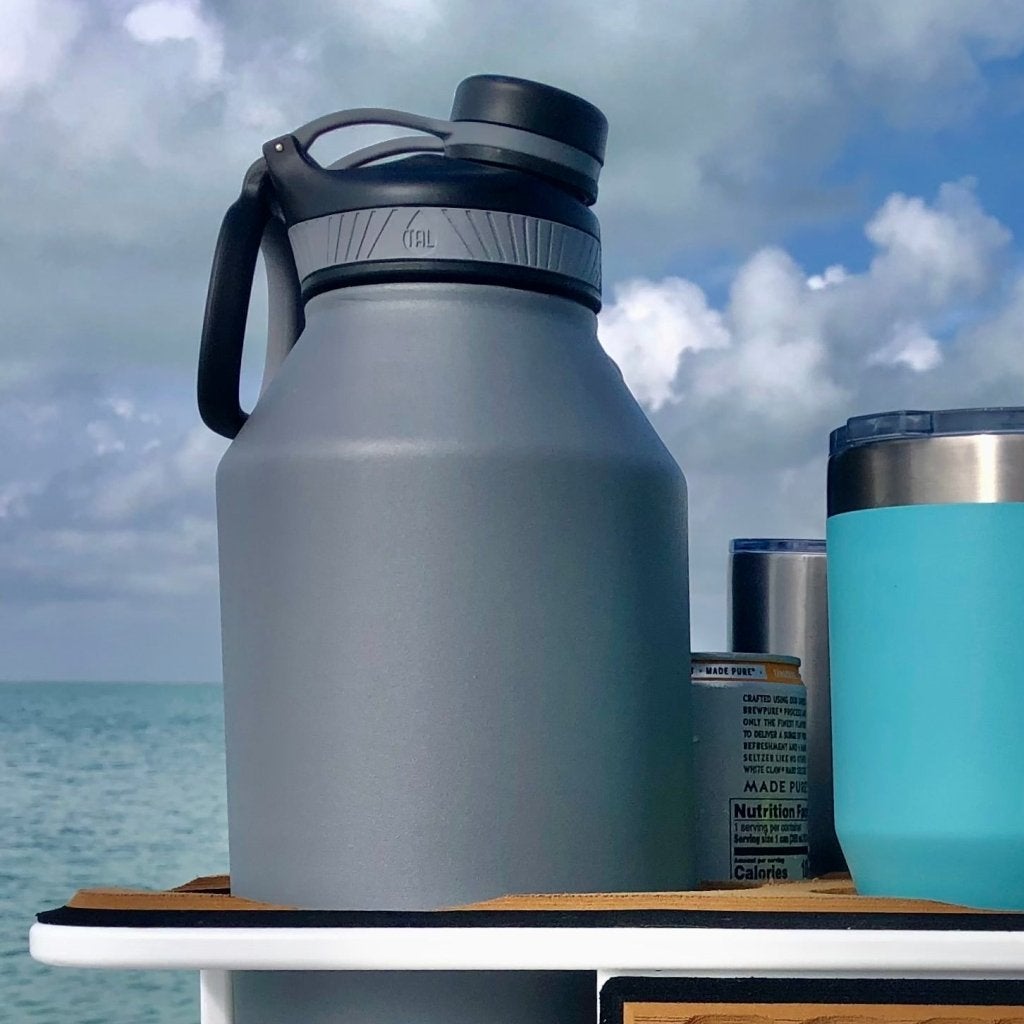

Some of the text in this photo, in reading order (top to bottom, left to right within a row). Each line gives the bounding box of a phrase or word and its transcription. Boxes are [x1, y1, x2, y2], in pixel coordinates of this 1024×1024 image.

[406, 229, 435, 248] TAL
[706, 667, 729, 675] MADE
[743, 694, 771, 703] CRAFTED
[743, 718, 760, 727] ONLY
[764, 719, 776, 727] THE
[743, 730, 752, 738] TO
[754, 730, 778, 739] DELIVER
[743, 742, 788, 751] REFRESHMENT
[743, 754, 774, 762] SELTZER
[776, 754, 788, 763] LIKE
[743, 765, 764, 774] WHITE
[743, 780, 786, 793] MADE
[734, 803, 795, 819] Nutrition
[734, 823, 738, 832] 1
[740, 823, 768, 834] serving
[734, 834, 760, 845] Serving
[734, 864, 788, 880] Calories
